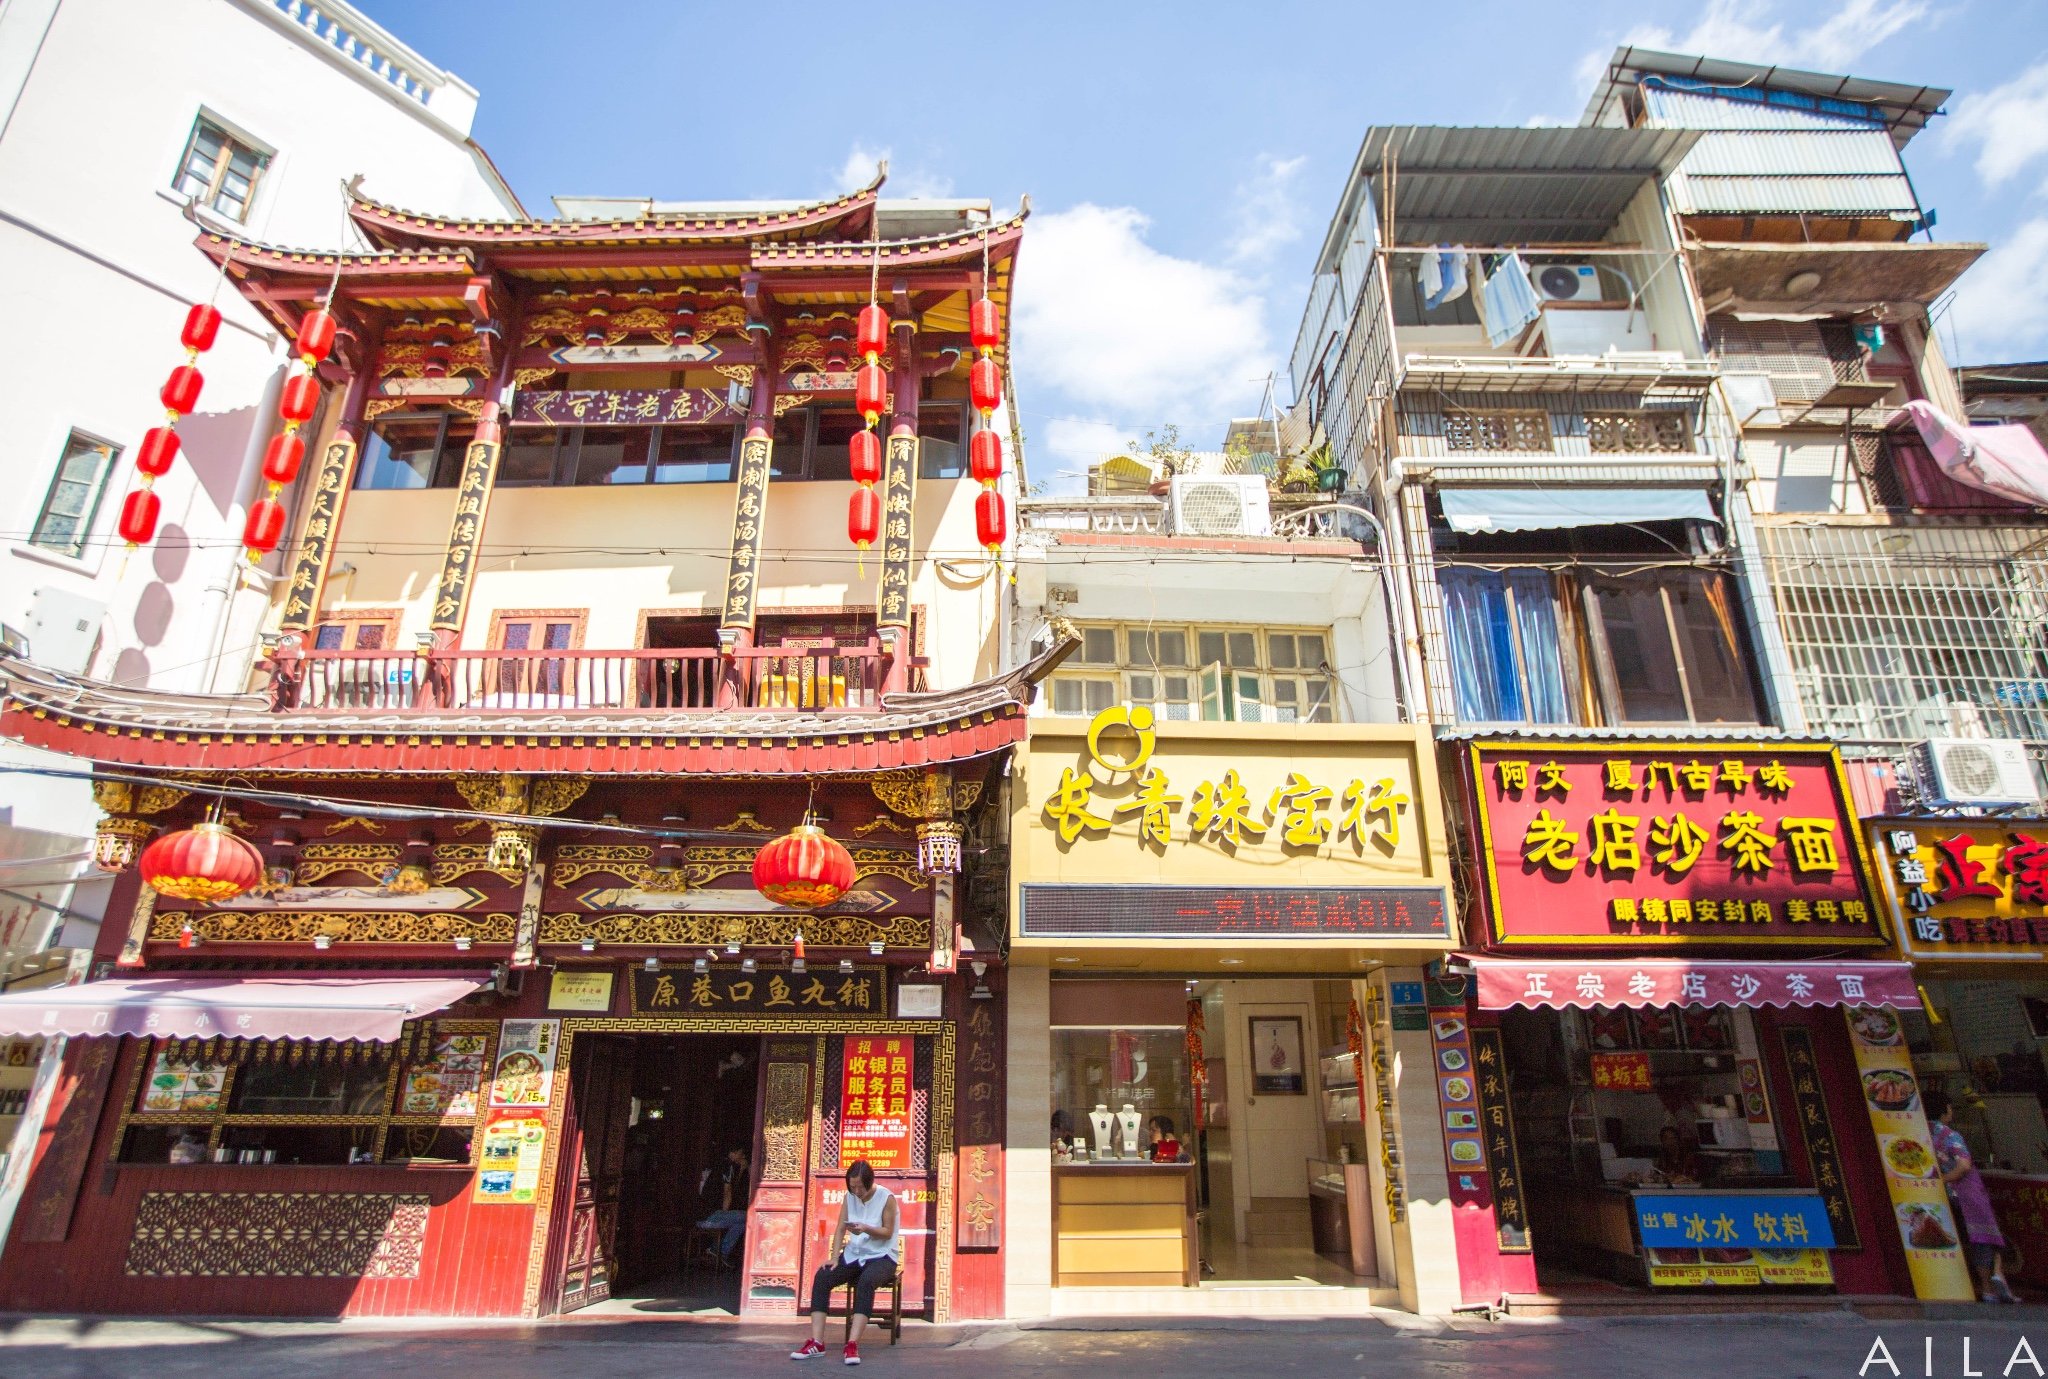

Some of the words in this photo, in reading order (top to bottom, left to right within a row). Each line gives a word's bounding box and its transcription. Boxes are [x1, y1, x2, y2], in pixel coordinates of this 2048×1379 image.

[567, 393, 692, 421] 百年老店
[729, 442, 767, 617] 密制高汤香万里
[1498, 760, 1572, 792] 阿文
[1608, 760, 1795, 792] 厦门古早味
[1045, 768, 1409, 848] 长青珠宝行
[1525, 808, 1840, 873] 老店沙茶面
[1890, 830, 1943, 942] 阿益小吃
[1613, 899, 1772, 923] 眼镜同安封肉
[1787, 899, 1868, 924] 姜母鸭
[651, 975, 871, 1009] 原巷口鱼丸铺
[1524, 971, 1866, 1000] 正宗老店沙茶面
[539, 1023, 551, 1054] 沙茶面
[858, 1040, 900, 1054] 招聘
[849, 1057, 907, 1075] 收银员
[527, 1091, 546, 1103] 15元
[848, 1077, 907, 1095] 服务员
[847, 1098, 907, 1116] 点菜员
[1479, 1044, 1519, 1221] 传承百年品牌
[1642, 1213, 1678, 1229] 出售
[1682, 1212, 1739, 1243] 冰水
[1753, 1212, 1809, 1243] 饮料
